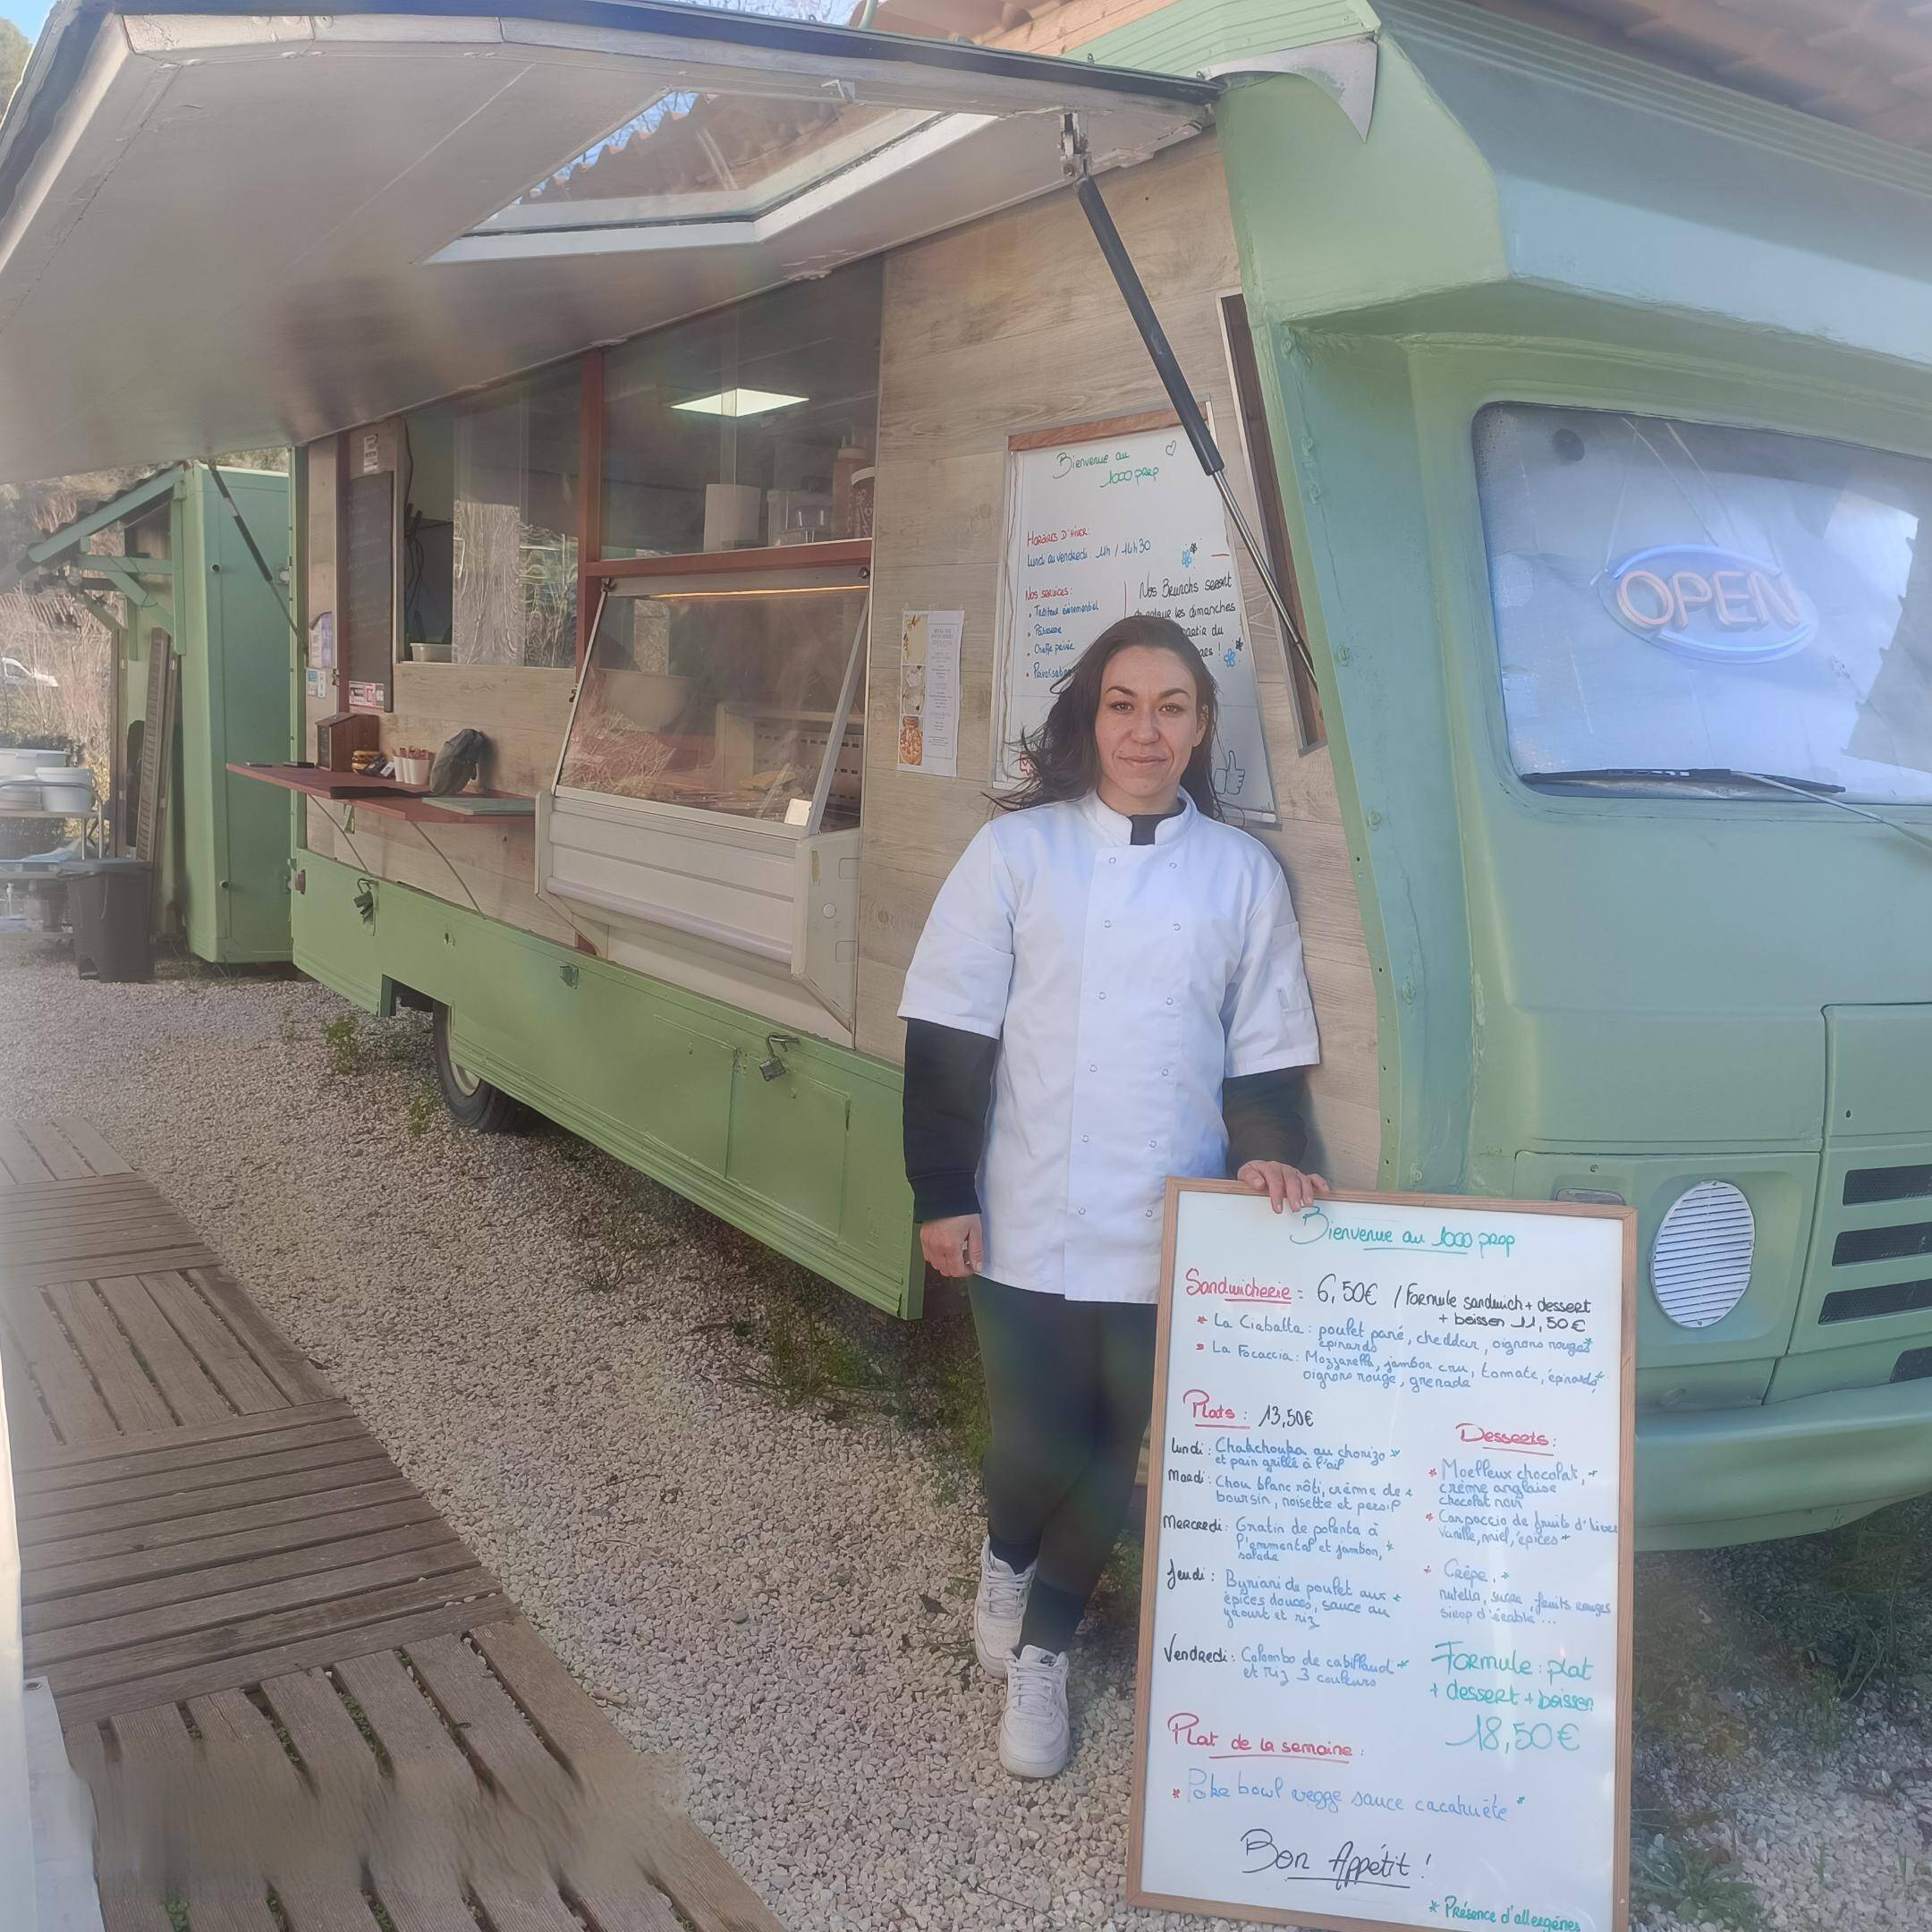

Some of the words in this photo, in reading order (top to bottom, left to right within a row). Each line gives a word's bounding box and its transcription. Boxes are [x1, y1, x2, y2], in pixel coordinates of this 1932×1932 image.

[1052, 452, 1109, 479] Bienvenue
[1115, 451, 1131, 462] au
[1616, 569, 1804, 631] OPEN
[1211, 623, 1224, 637] du
[1289, 1204, 1394, 1246] Bienvenue
[1402, 1229, 1426, 1245] au
[1317, 1272, 1378, 1306] 6,50€
[1537, 1297, 1592, 1315] dessert
[1214, 1312, 1233, 1329] La
[1318, 1317, 1366, 1342] poulet
[1211, 1339, 1232, 1355] La
[1257, 1403, 1315, 1428] 13,50€
[1214, 1454, 1227, 1466] et
[1230, 1455, 1259, 1471] pain
[1313, 1445, 1335, 1458] au
[1215, 1475, 1252, 1492] Chou
[1257, 1476, 1292, 1494] blanc
[1382, 1482, 1402, 1498] de
[1336, 1497, 1353, 1513] et
[1234, 1515, 1285, 1535] Gratin
[1291, 1519, 1309, 1536] de
[1512, 1513, 1530, 1528] de
[1318, 1538, 1333, 1554] et
[1284, 1576, 1301, 1593] de
[1305, 1575, 1353, 1600] poulet
[1360, 1589, 1387, 1601] aux
[1274, 1609, 1287, 1622] et
[1321, 1598, 1361, 1614] sauce
[1368, 1605, 1391, 1619] au
[1301, 1648, 1320, 1667] de
[1243, 1664, 1258, 1679] et
[1297, 1667, 1310, 1682] 3
[1316, 1669, 1377, 1688] couleurs
[1546, 1656, 1595, 1686] plat
[1445, 1677, 1521, 1706] dessert
[1166, 1711, 1219, 1747] Plat
[1231, 1733, 1252, 1751] de
[1259, 1737, 1275, 1753] la
[1187, 1767, 1232, 1804] Poke
[1238, 1769, 1284, 1799] bowl
[1351, 1791, 1404, 1812] sauce
[1240, 1827, 1310, 1874] Bon
[1445, 1894, 1496, 1924] Présence
